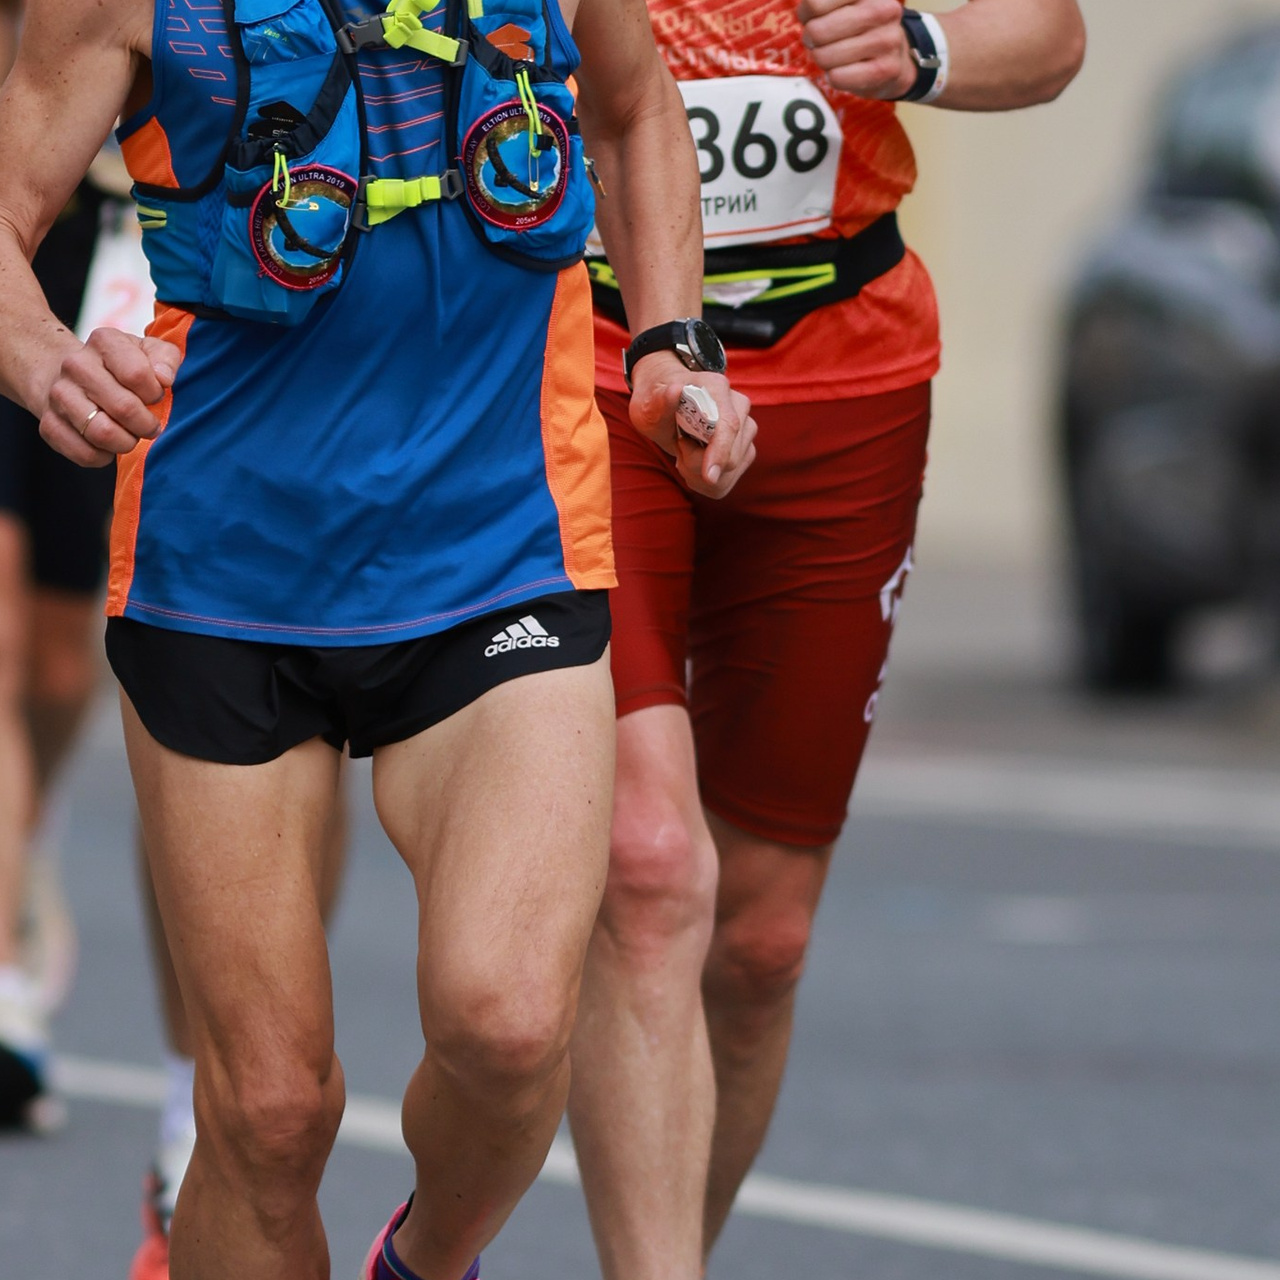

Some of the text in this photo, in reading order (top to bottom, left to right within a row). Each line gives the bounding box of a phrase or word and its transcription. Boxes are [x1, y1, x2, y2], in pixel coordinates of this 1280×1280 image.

[687, 98, 829, 184] 368
[298, 172, 325, 181] ULTRA
[326, 175, 345, 189] 2019
[701, 188, 758, 217] ТРИЙ
[484, 635, 560, 658] adidas
